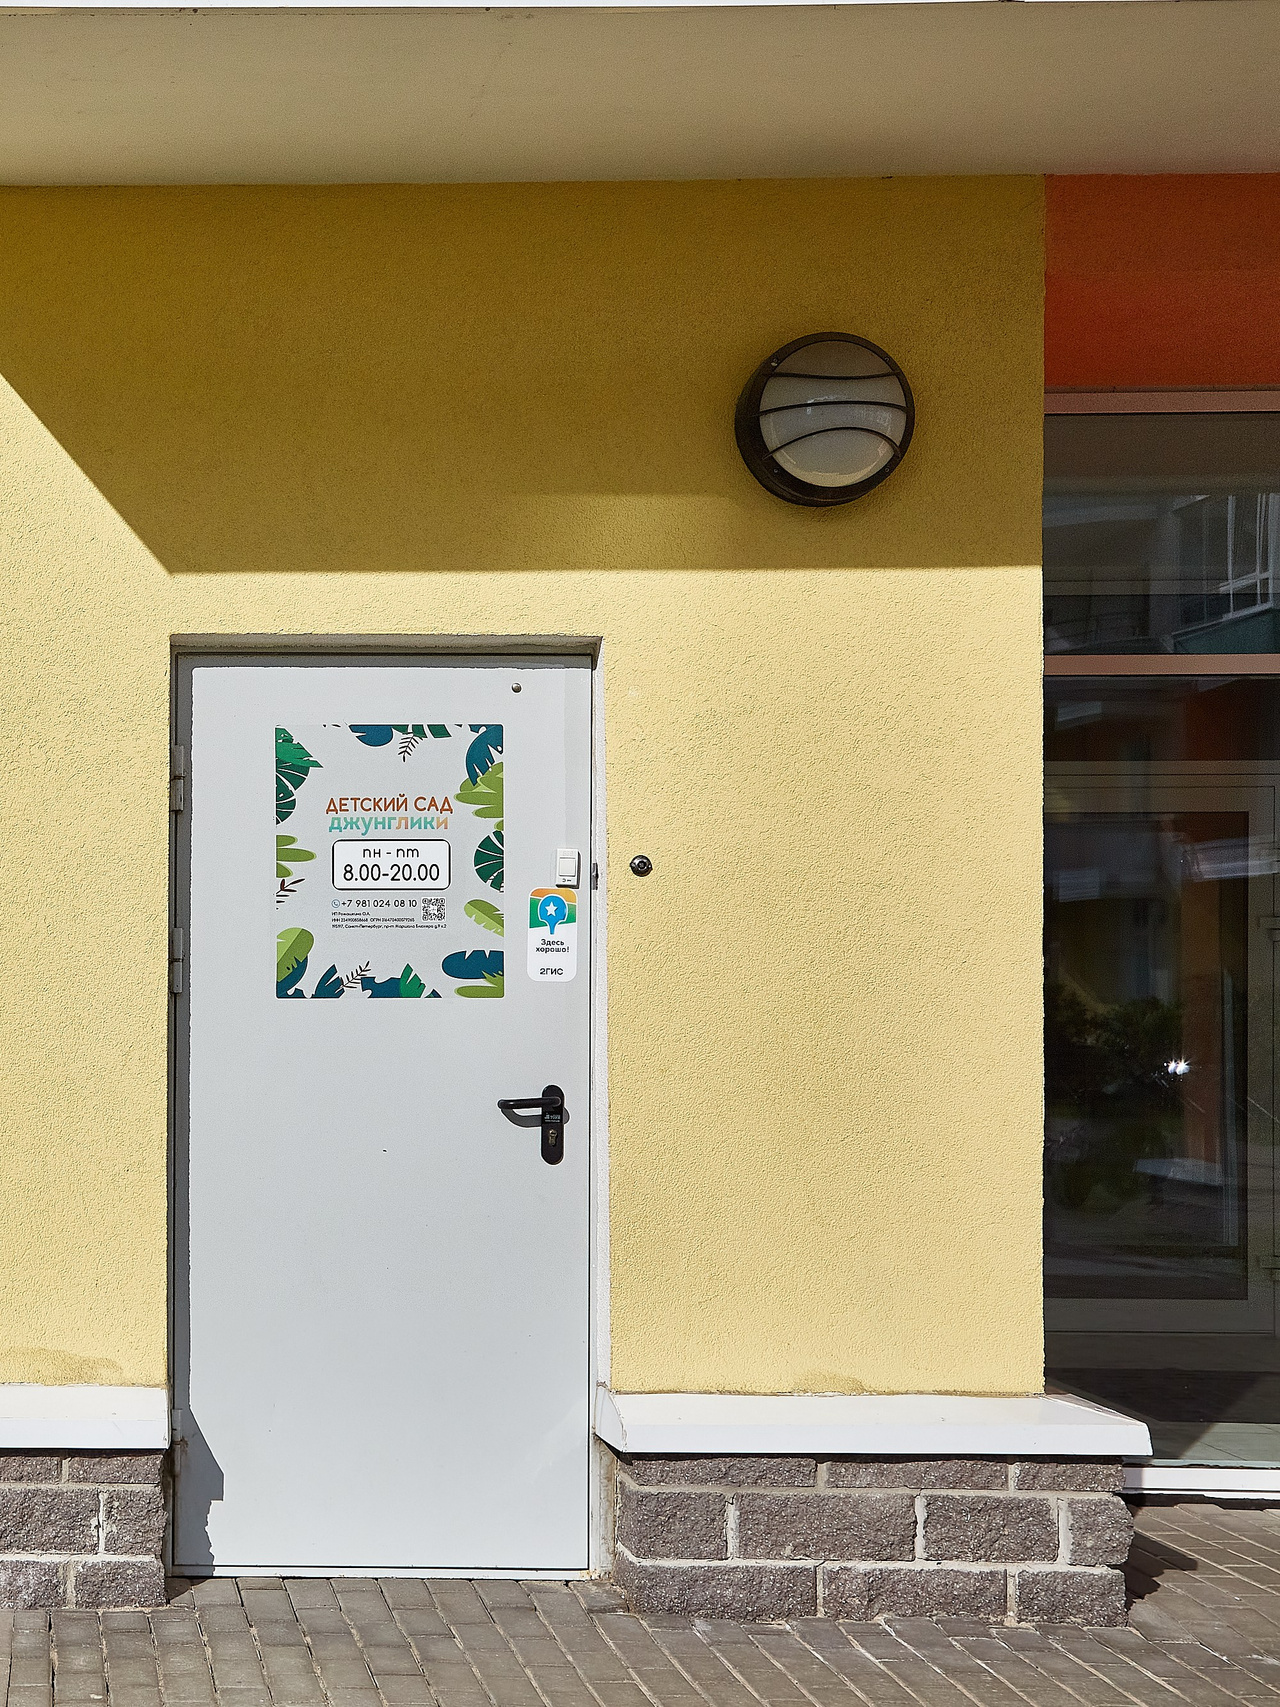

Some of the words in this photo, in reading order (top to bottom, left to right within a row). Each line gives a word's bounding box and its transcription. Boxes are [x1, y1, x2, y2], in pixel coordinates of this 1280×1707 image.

[326, 793, 408, 814] ДЕТСКИЙ
[414, 796, 453, 814] САД
[328, 816, 449, 836] джунглики
[363, 848, 381, 858] пн
[343, 863, 440, 881] 8.00-20.00
[341, 899, 352, 908] +7
[355, 899, 370, 908] 981
[373, 899, 391, 908] 024
[393, 899, 405, 908] 08
[408, 899, 417, 908] 10
[540, 938, 565, 947] Здесь
[535, 945, 570, 954] хорошо!
[539, 967, 564, 976] 2ГИС
